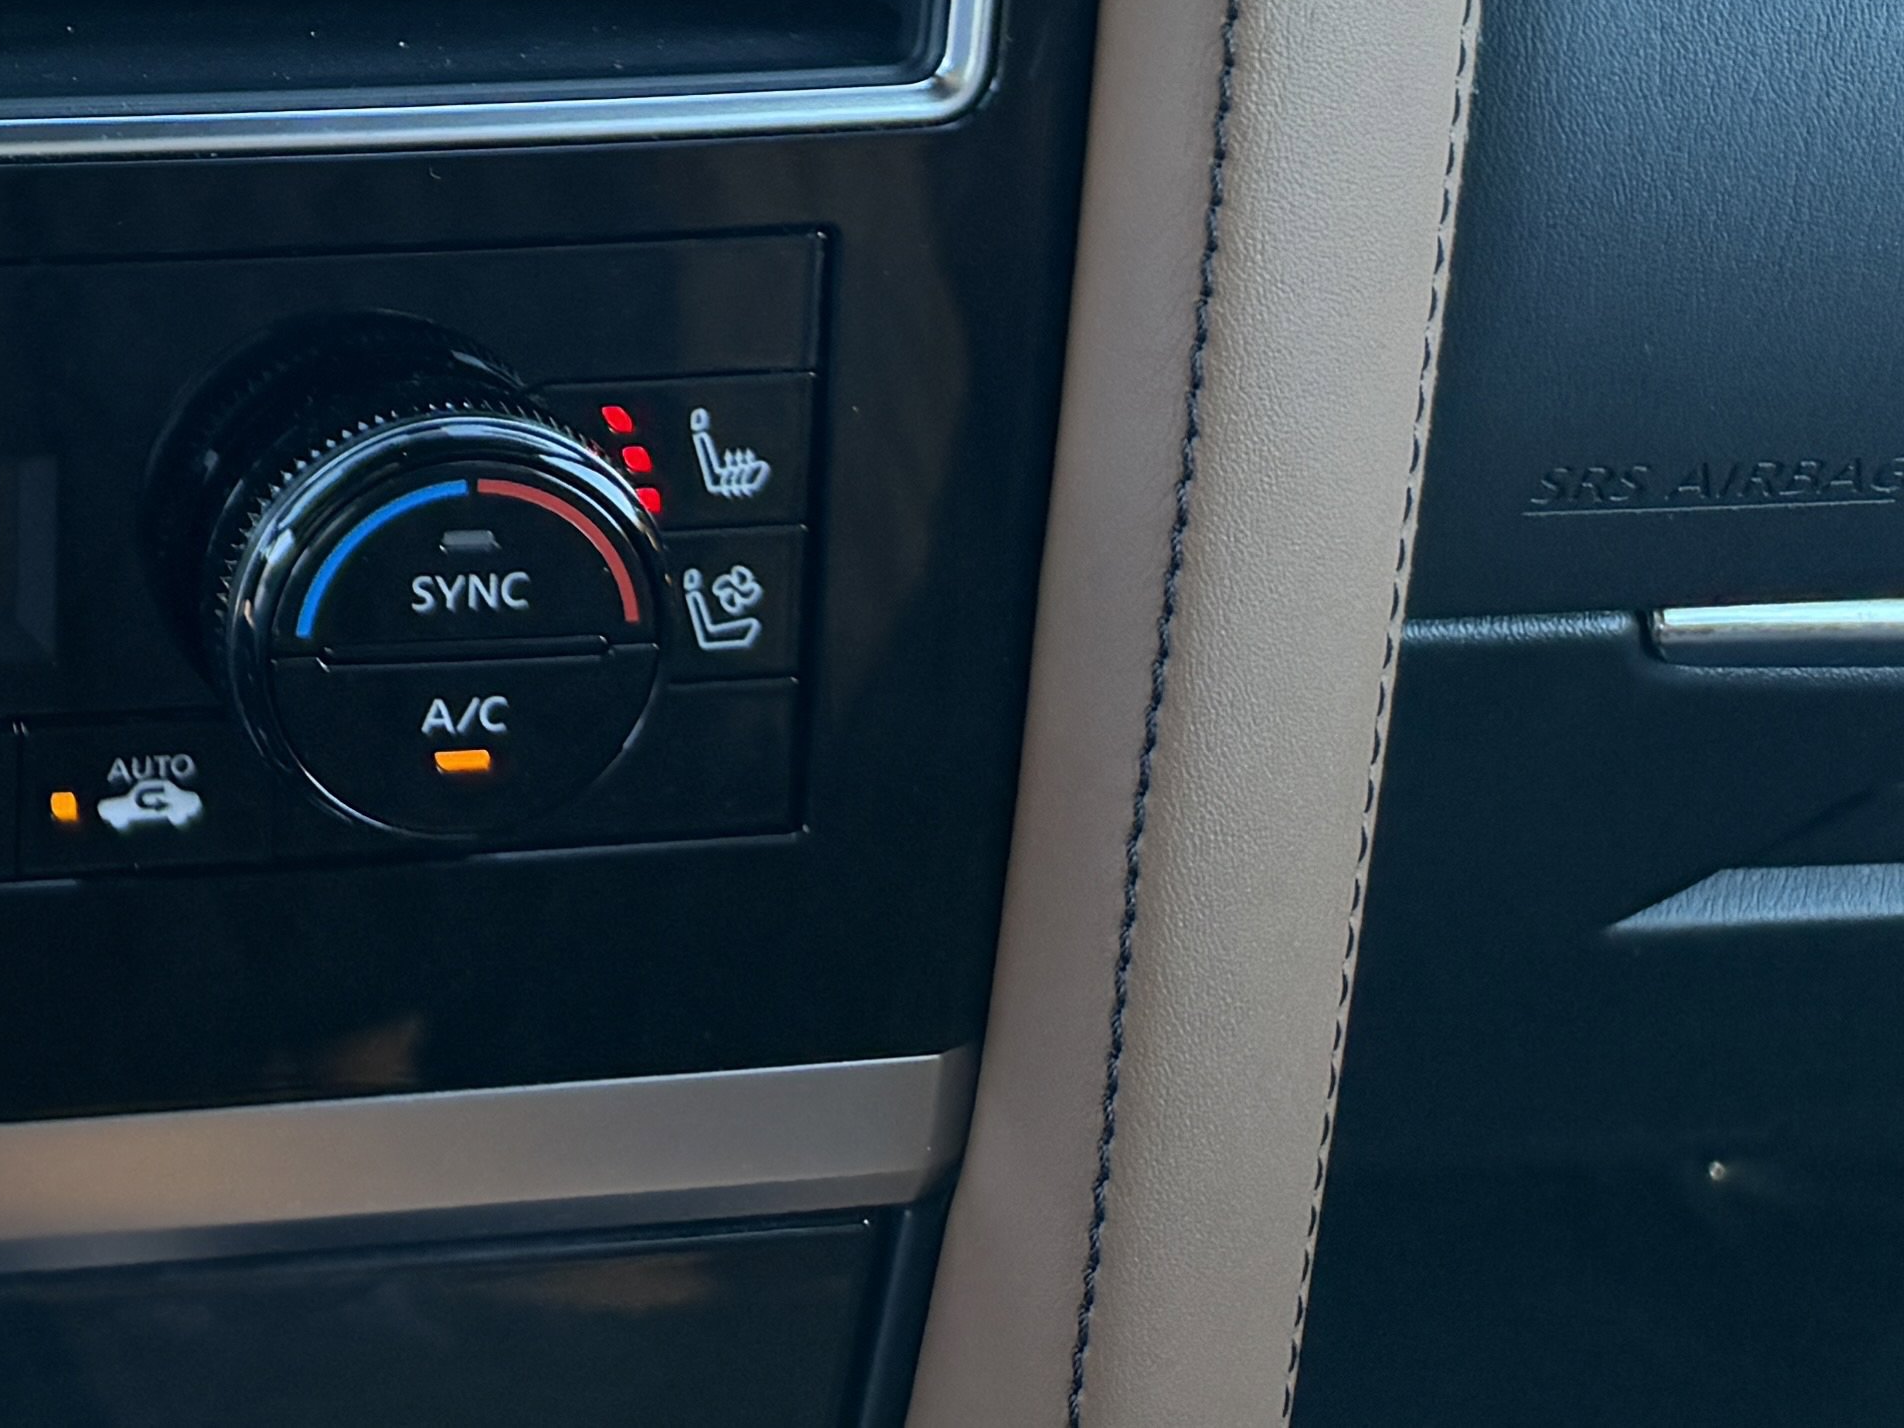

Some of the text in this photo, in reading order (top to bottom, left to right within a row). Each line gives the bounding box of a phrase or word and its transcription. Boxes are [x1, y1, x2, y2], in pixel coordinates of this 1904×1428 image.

[1528, 462, 1653, 506] SRS
[410, 569, 533, 615] SYNC
[421, 694, 512, 738] A/C
[106, 753, 195, 786] AUTO
